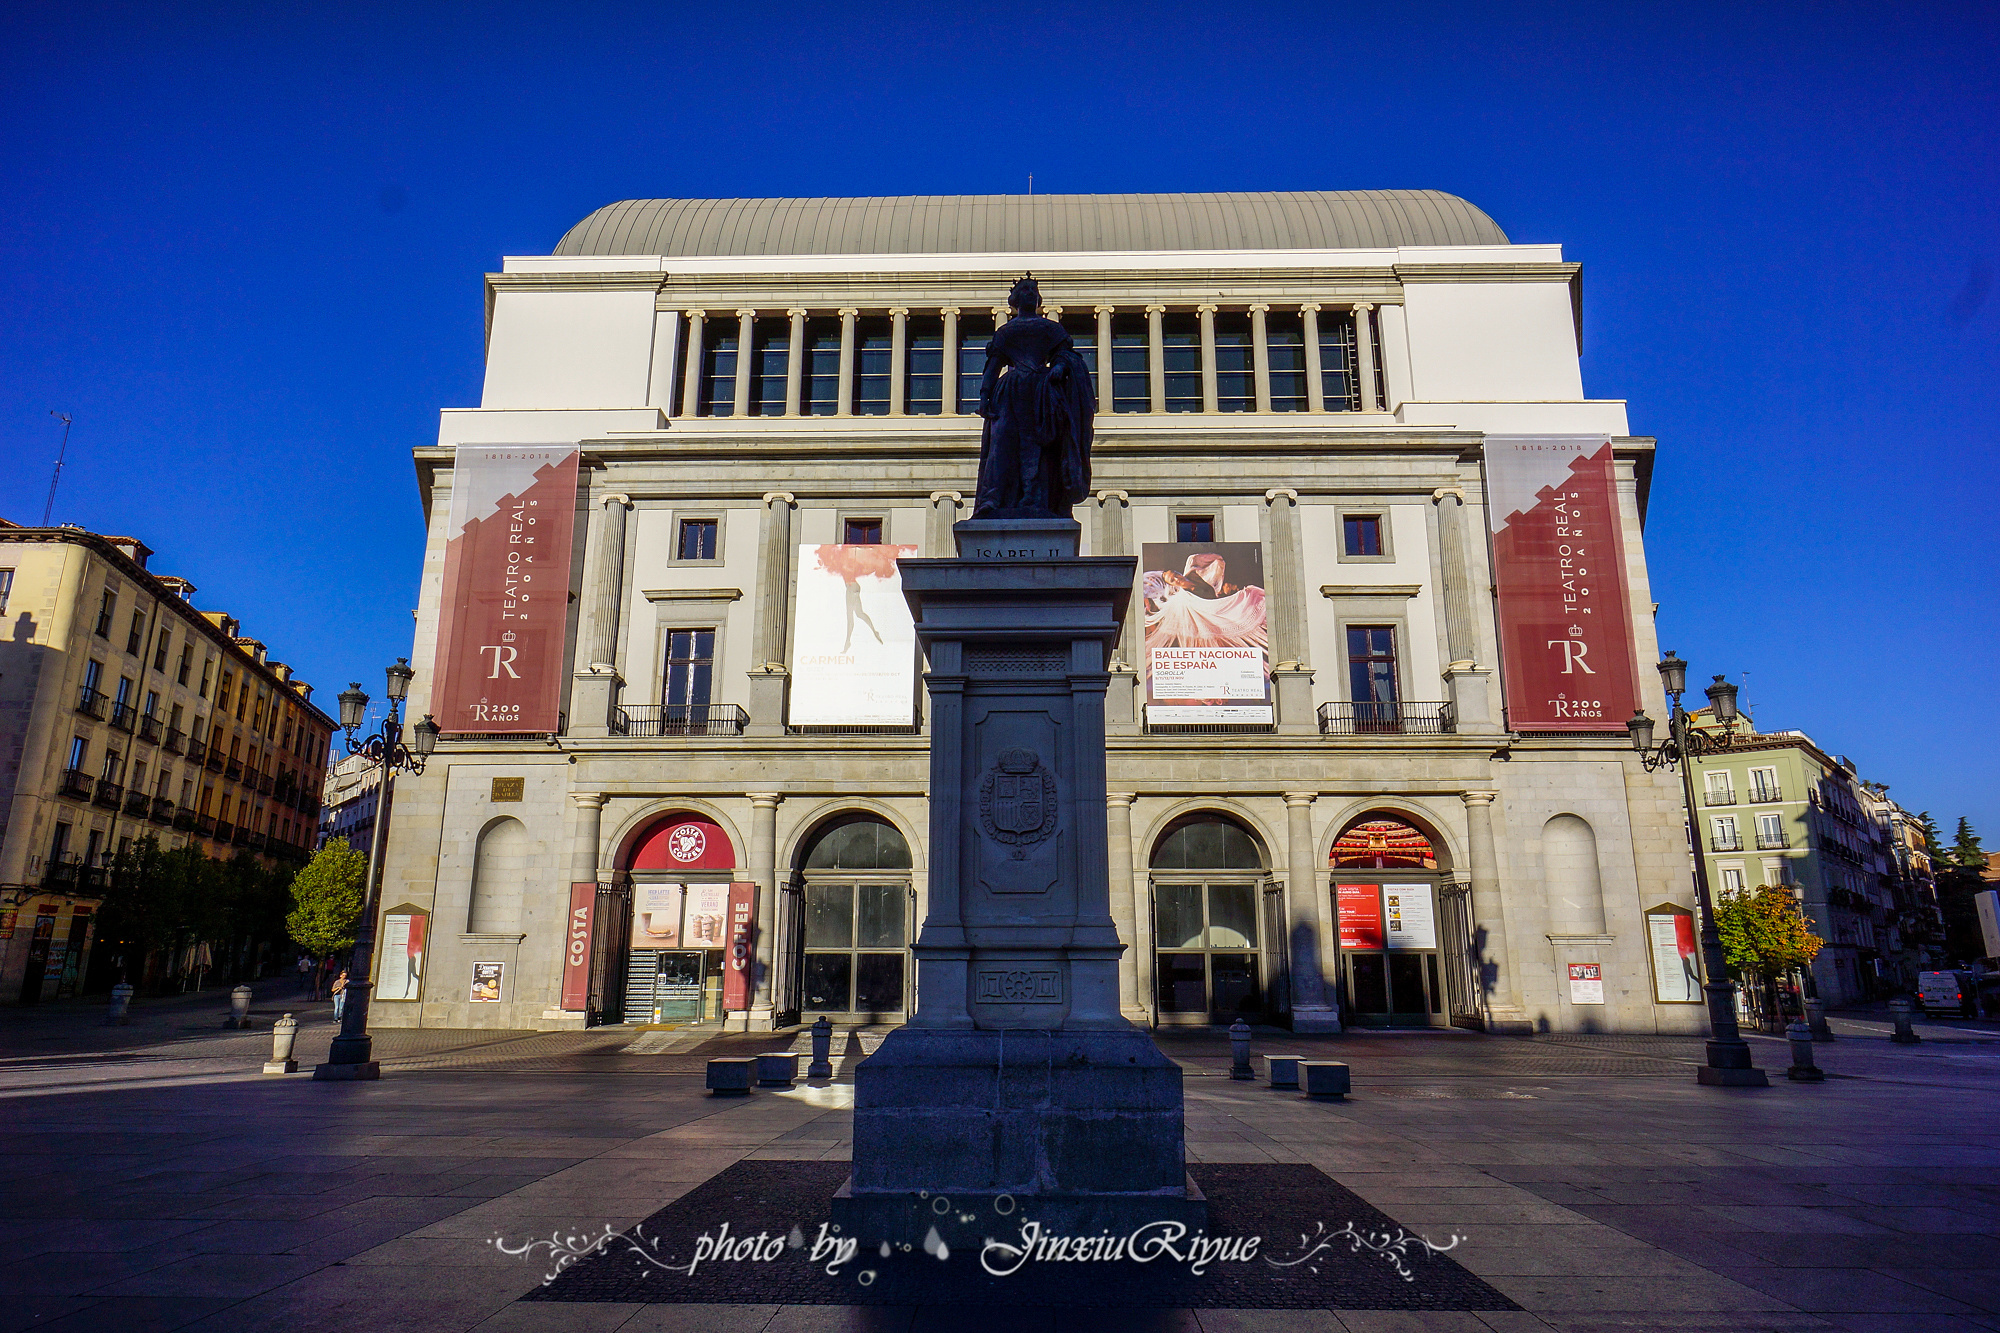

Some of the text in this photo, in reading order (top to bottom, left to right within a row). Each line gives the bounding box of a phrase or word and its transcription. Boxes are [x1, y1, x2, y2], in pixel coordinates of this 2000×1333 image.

[1554, 492, 1577, 614] TEATRO REAL
[502, 500, 525, 620] TEATRO REAL
[1155, 650, 1256, 658] BALLET NACIONAL
[800, 656, 855, 664] CARMEN
[1174, 659, 1217, 669] ESPAÑA
[492, 704, 520, 712] 200
[1572, 700, 1601, 708] 200
[492, 712, 519, 721] AÑOS
[1573, 708, 1602, 718] AÑOS
[676, 828, 699, 838] COSTA
[673, 847, 701, 859] COFFEE
[570, 907, 588, 966] COSTA
[732, 902, 749, 970] COFFEE
